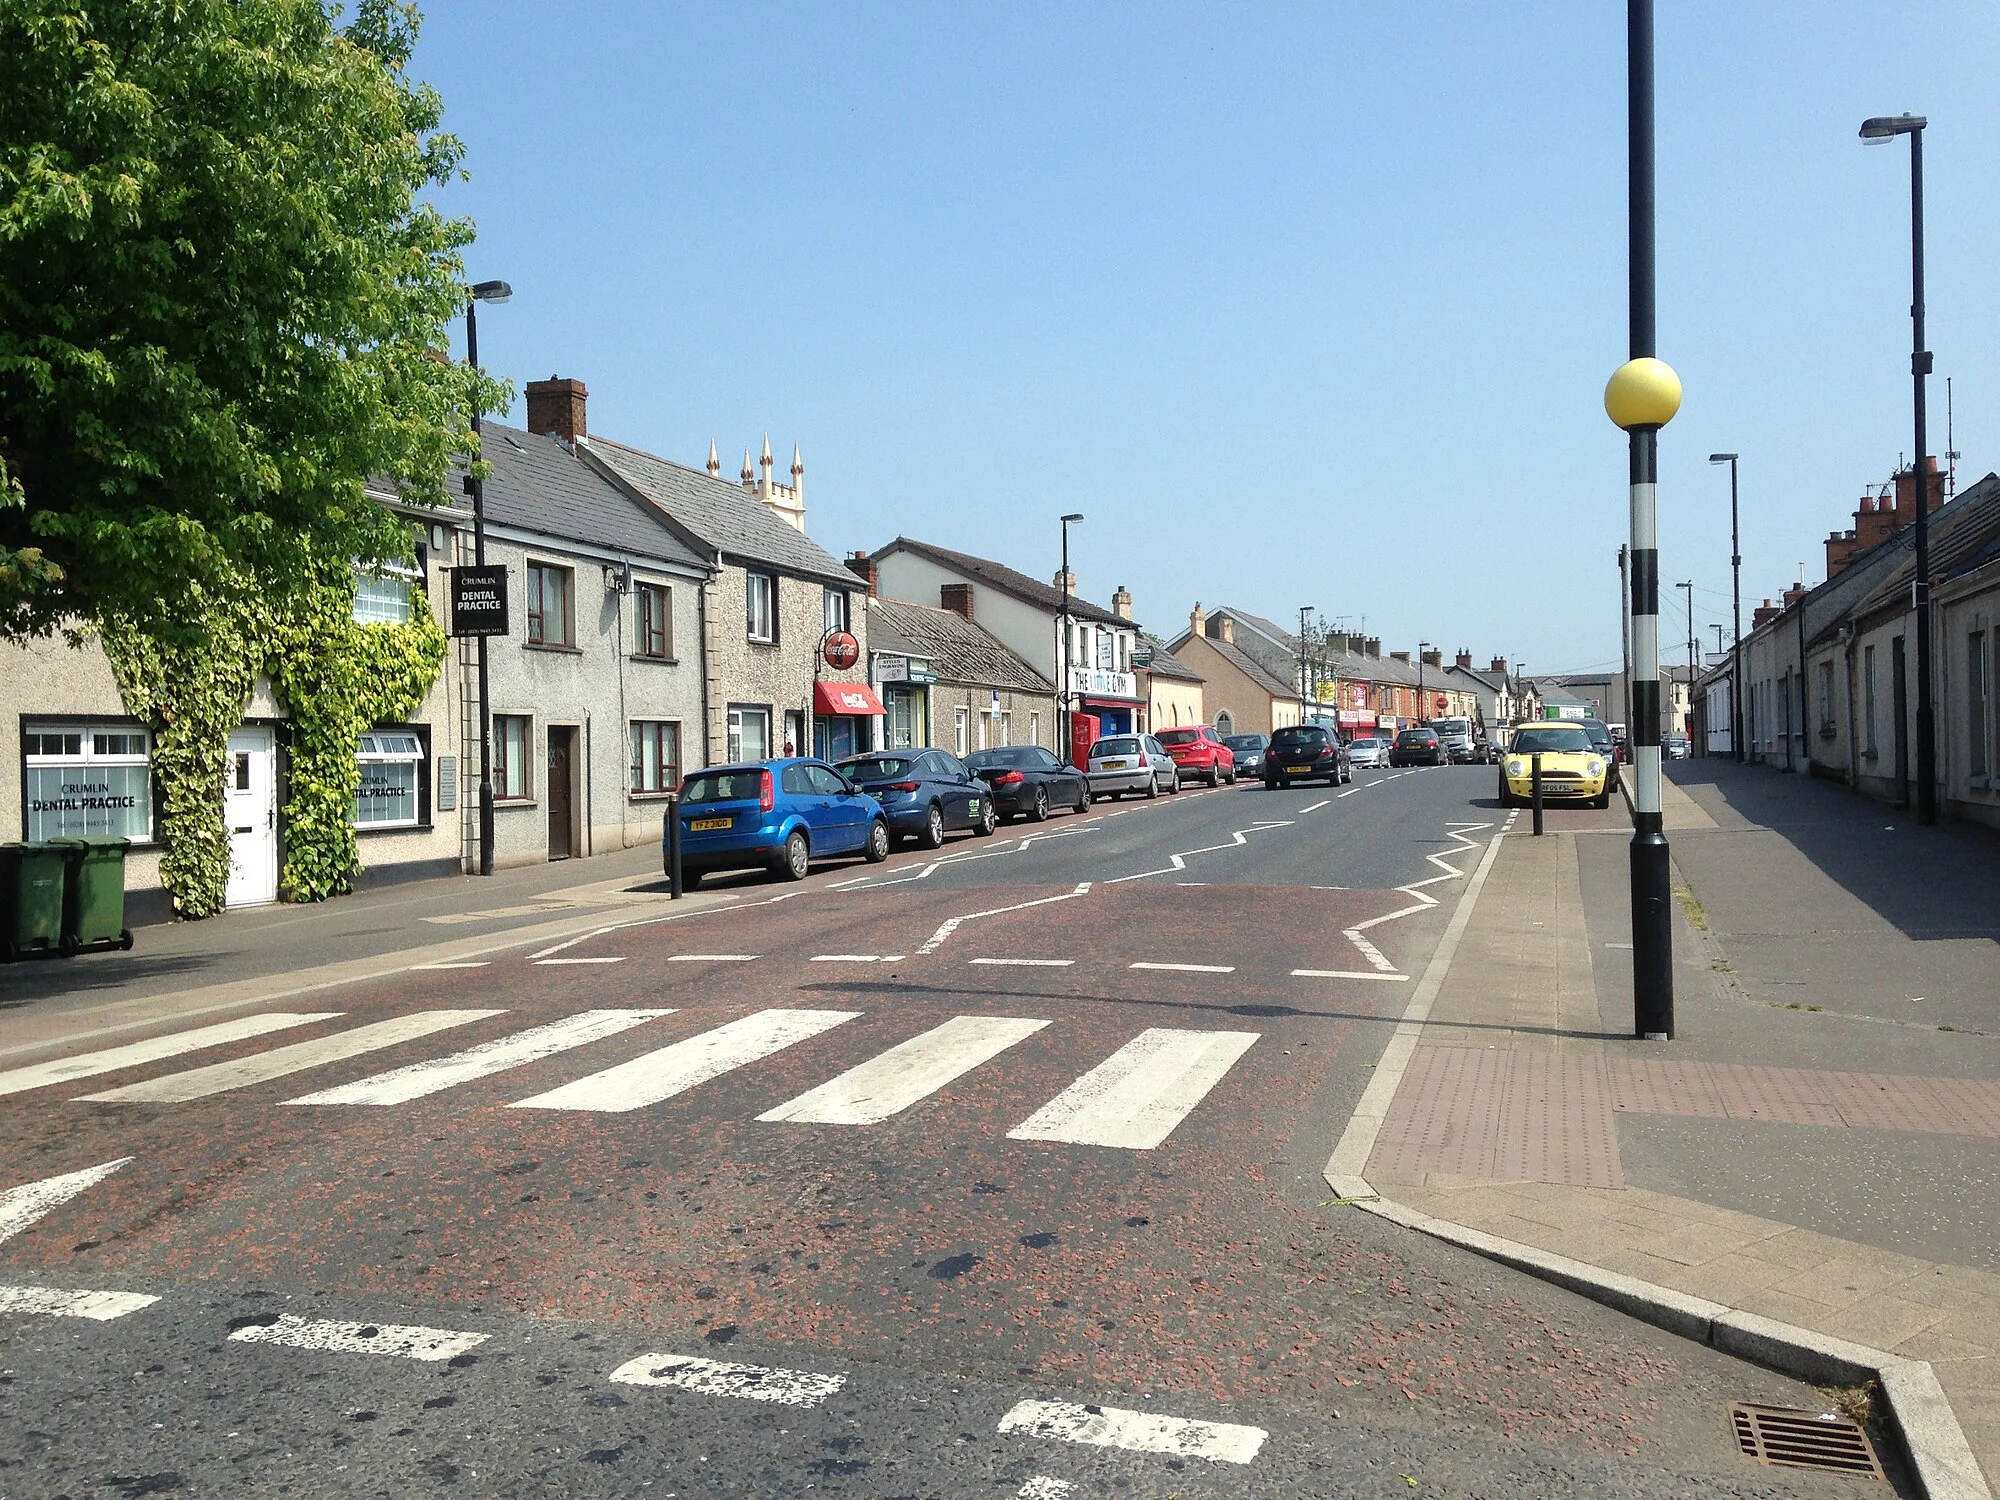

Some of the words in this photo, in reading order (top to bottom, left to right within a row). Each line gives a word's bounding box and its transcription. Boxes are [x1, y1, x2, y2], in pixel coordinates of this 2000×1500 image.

[461, 577, 496, 585] CRUMLIN
[461, 591, 496, 601] DENTAL
[457, 600, 501, 611] PRACTICE
[1075, 671, 1088, 691] THE
[1112, 674, 1127, 693] GYM
[362, 777, 389, 785] RUMLIN
[61, 783, 109, 794] CRUMLIN
[370, 787, 406, 798] PRACTICE
[33, 797, 79, 812] DENTAL
[81, 796, 135, 809] PRACTICE
